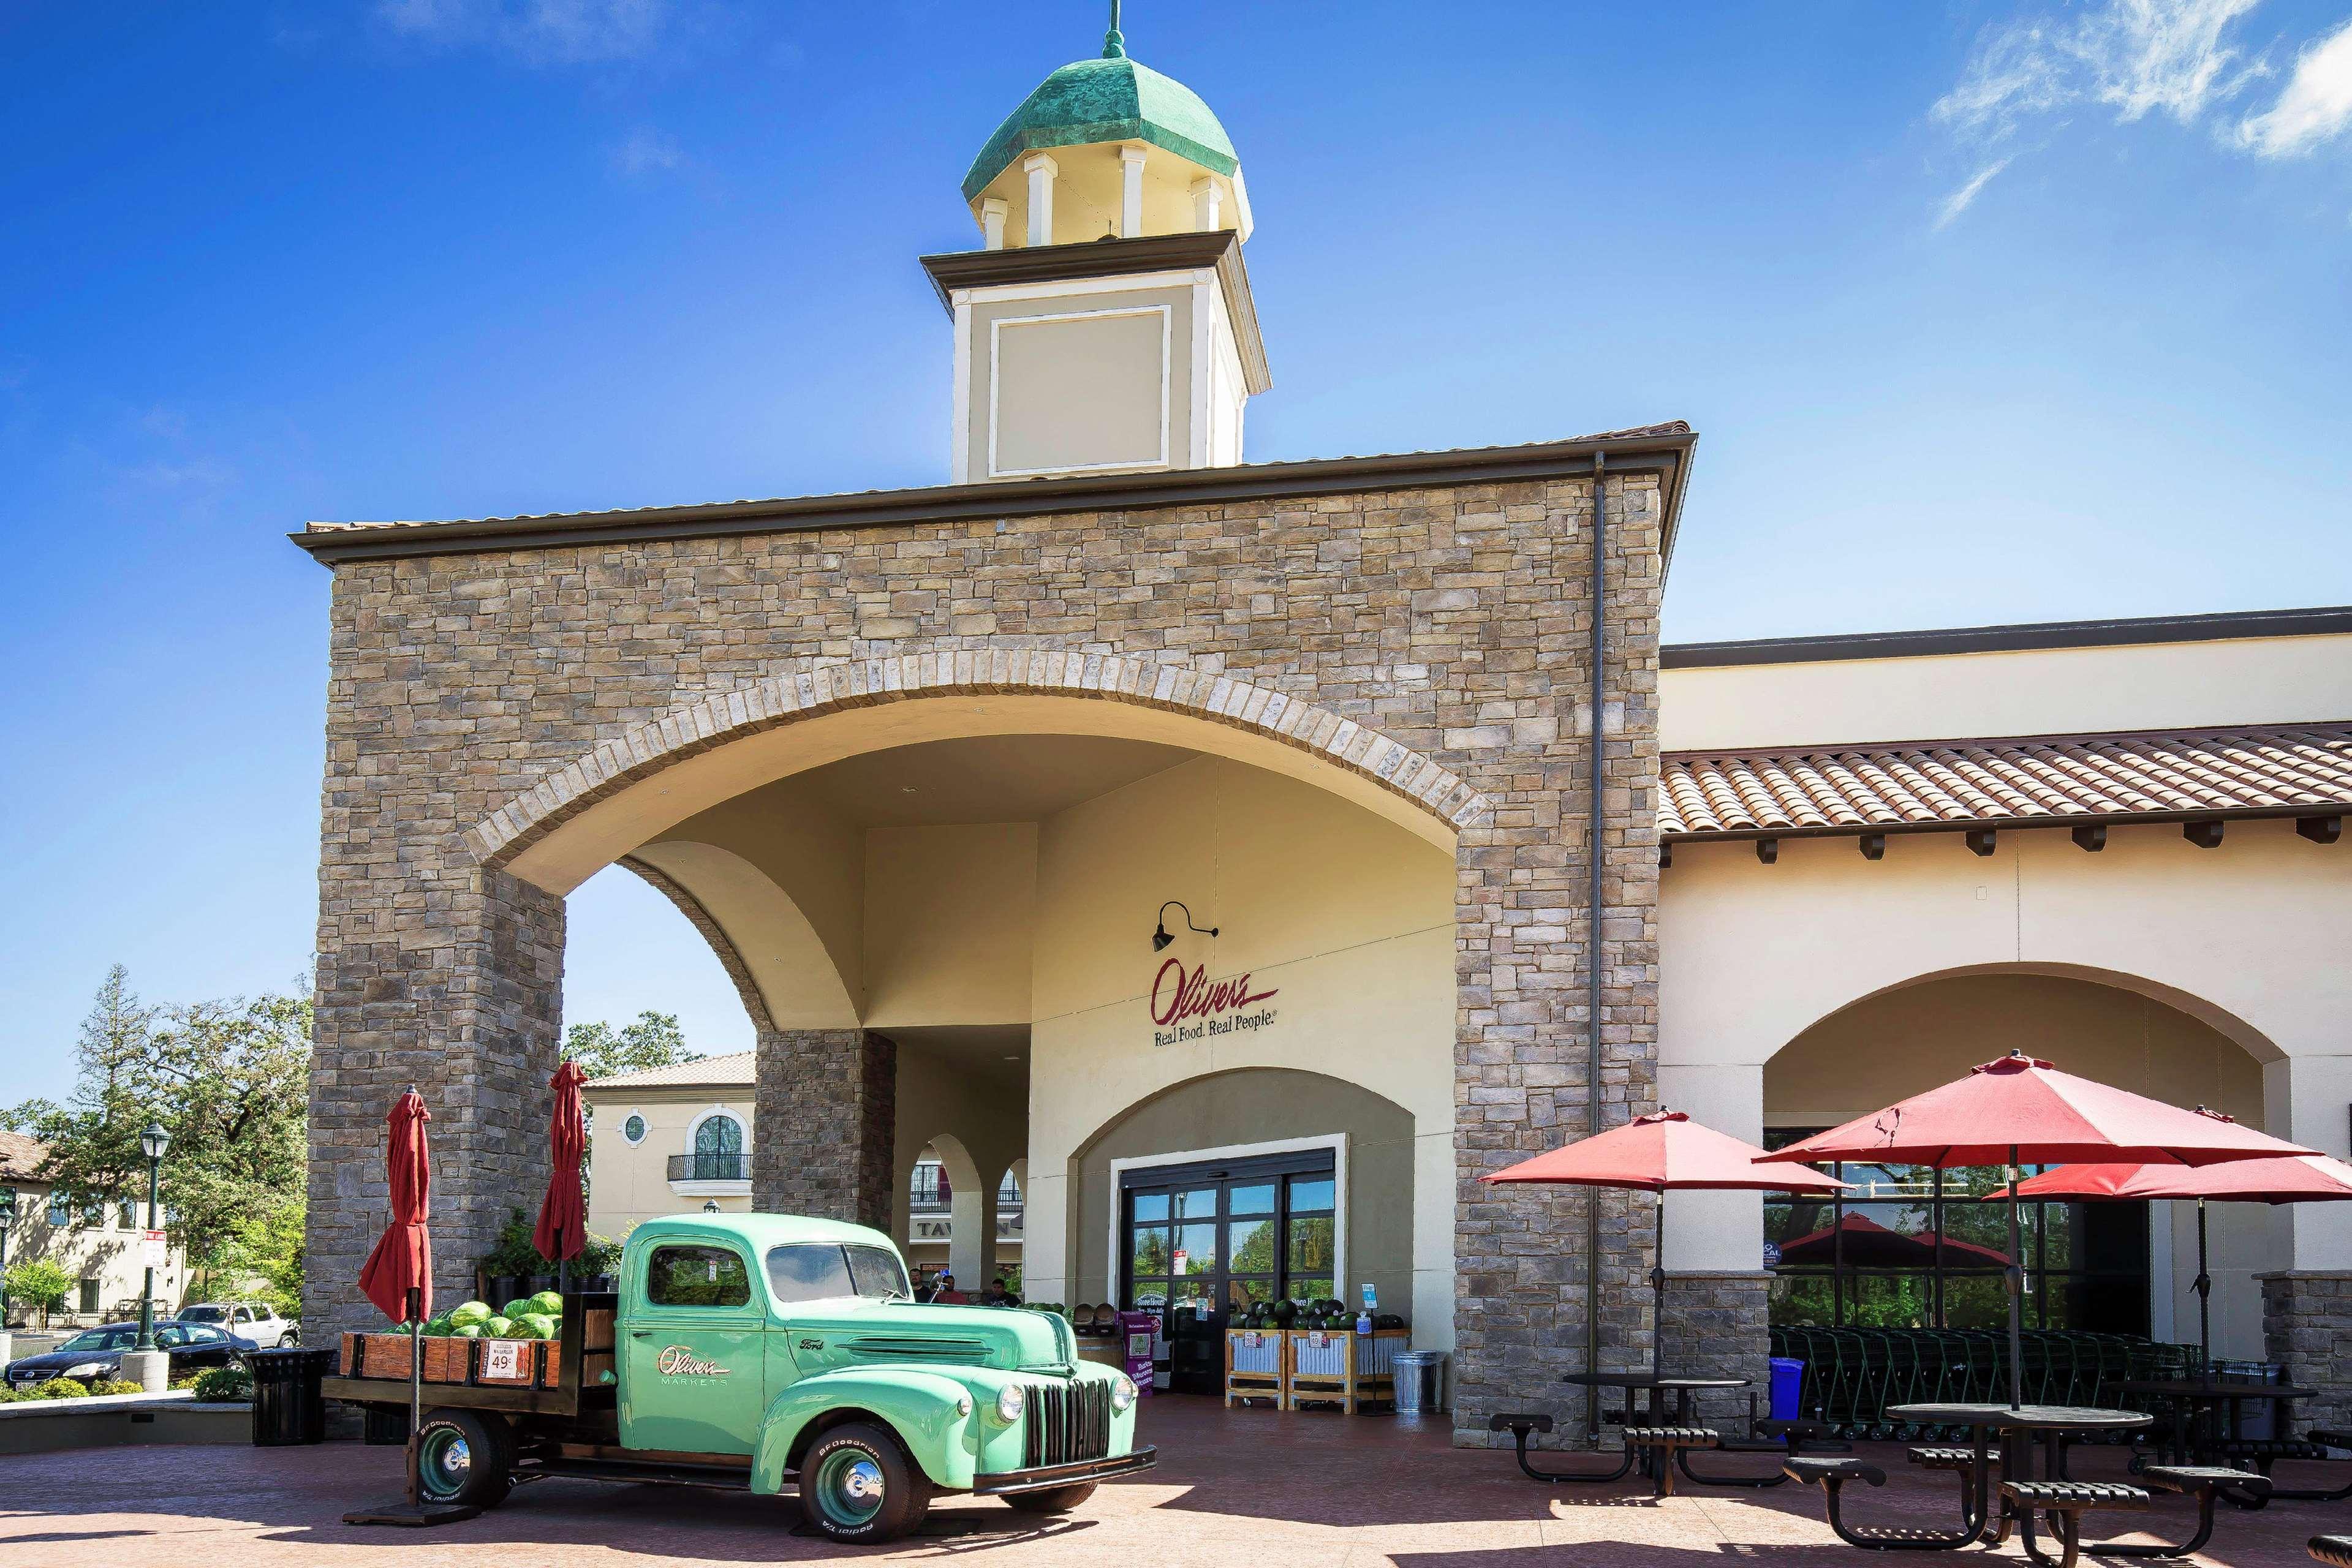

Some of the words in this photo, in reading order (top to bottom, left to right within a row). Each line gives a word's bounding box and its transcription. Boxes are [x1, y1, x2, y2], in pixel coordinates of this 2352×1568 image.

[1151, 958, 1279, 1026] Oliver's
[1155, 1027, 1176, 1046] Real
[1179, 1022, 1205, 1041] Food.
[1209, 1017, 1232, 1036] Real
[1150, 1297, 1165, 1306] Hours
[799, 1339, 823, 1350] Ford
[839, 1523, 873, 1535] Radial
